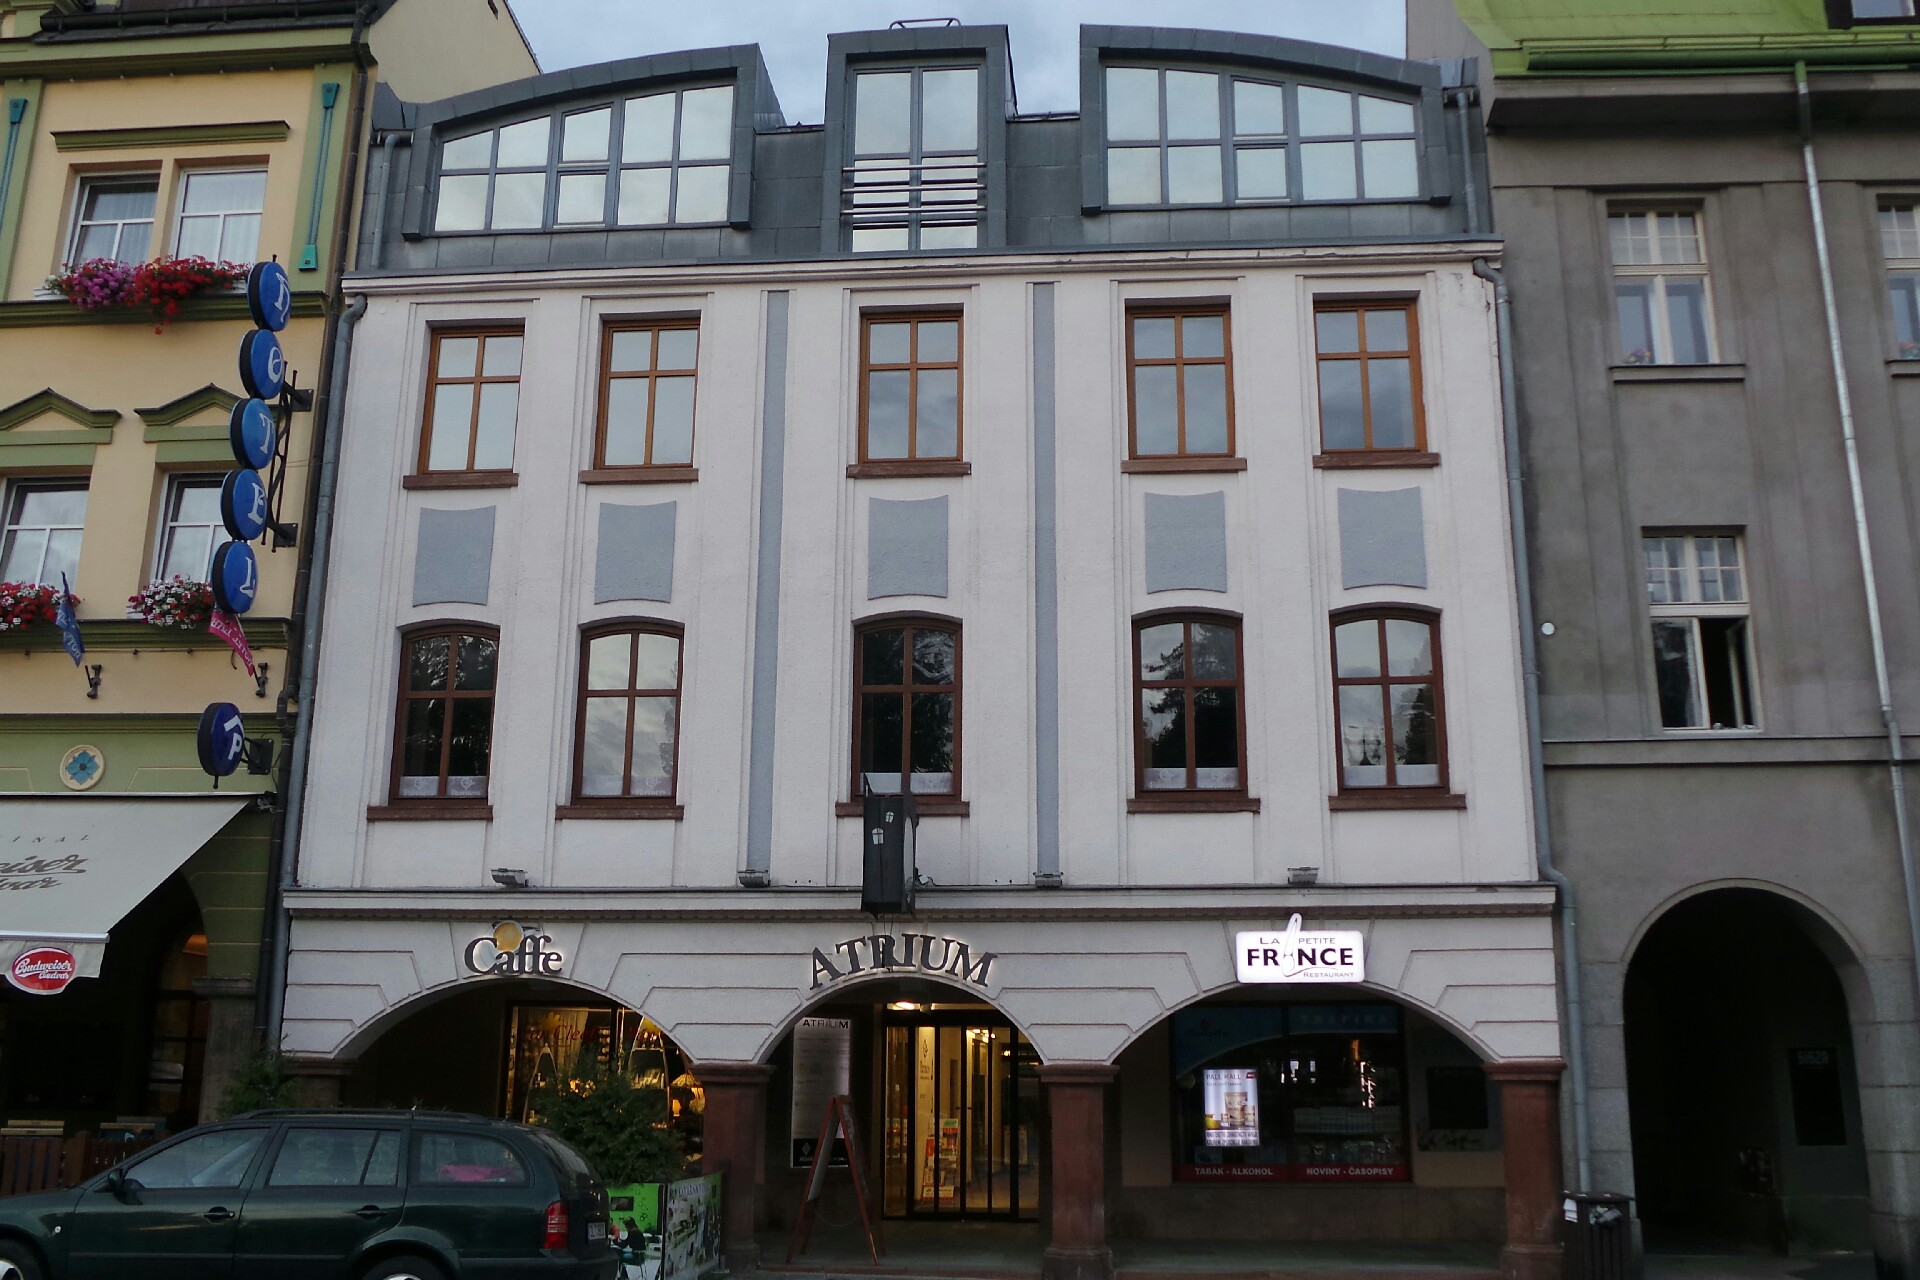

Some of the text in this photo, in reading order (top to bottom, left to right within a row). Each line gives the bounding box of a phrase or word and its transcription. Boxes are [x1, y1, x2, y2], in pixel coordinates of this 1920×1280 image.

[1298, 937, 1336, 945] PETITE
[15, 957, 73, 976] Budweiser
[809, 933, 999, 990] ATRIUM
[802, 1019, 849, 1029] ATRIUM
[1300, 1013, 1389, 1025] TRAFIKA
[1231, 1167, 1273, 1176] ALKOHOL
[1306, 1165, 1394, 1176] NOVINY ČASOPISY
